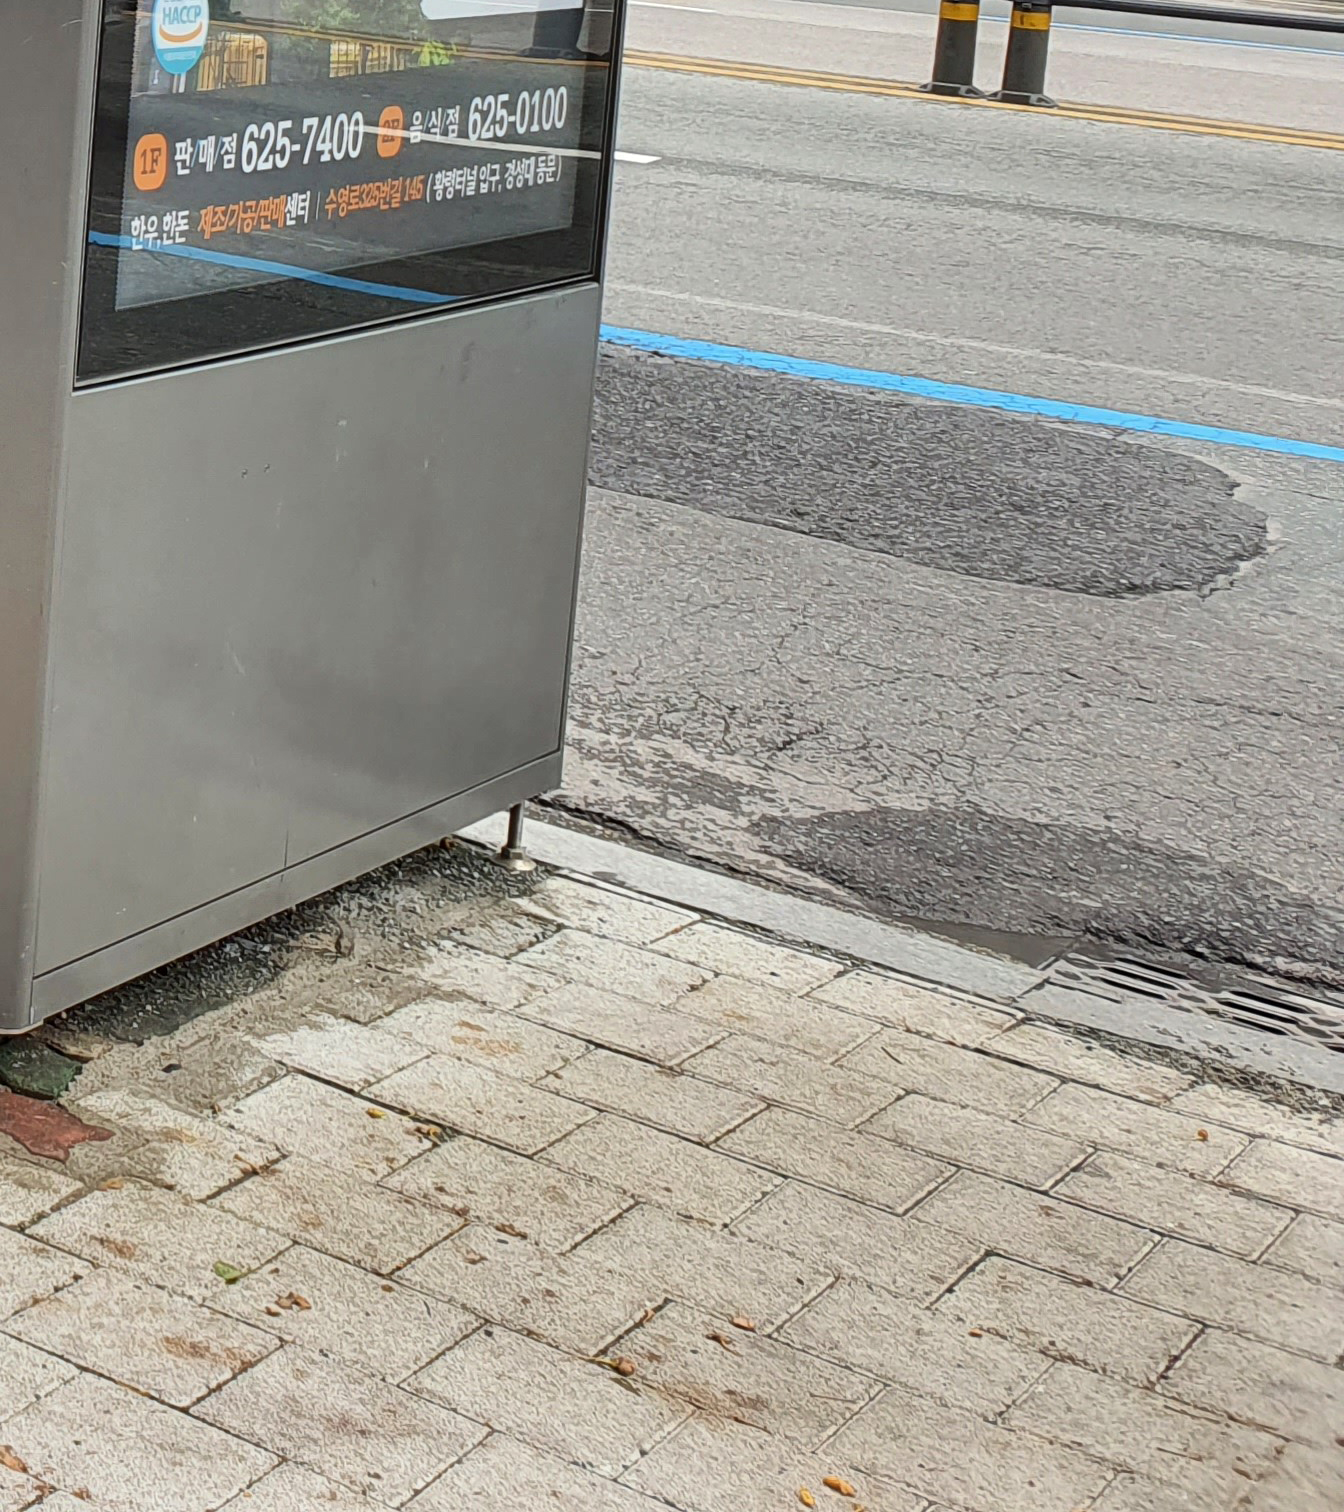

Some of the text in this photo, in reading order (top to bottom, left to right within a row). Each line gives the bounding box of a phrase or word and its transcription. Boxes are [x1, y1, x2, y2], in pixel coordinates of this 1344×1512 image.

[162, 5, 202, 27] HACCP
[138, 148, 163, 177] 1F
[240, 110, 365, 174] 625-7400
[467, 85, 567, 143] 625-0100
[130, 209, 190, 251] 한우,한돈
[324, 180, 402, 221] 수영로325번길
[504, 160, 537, 194] 경성대
